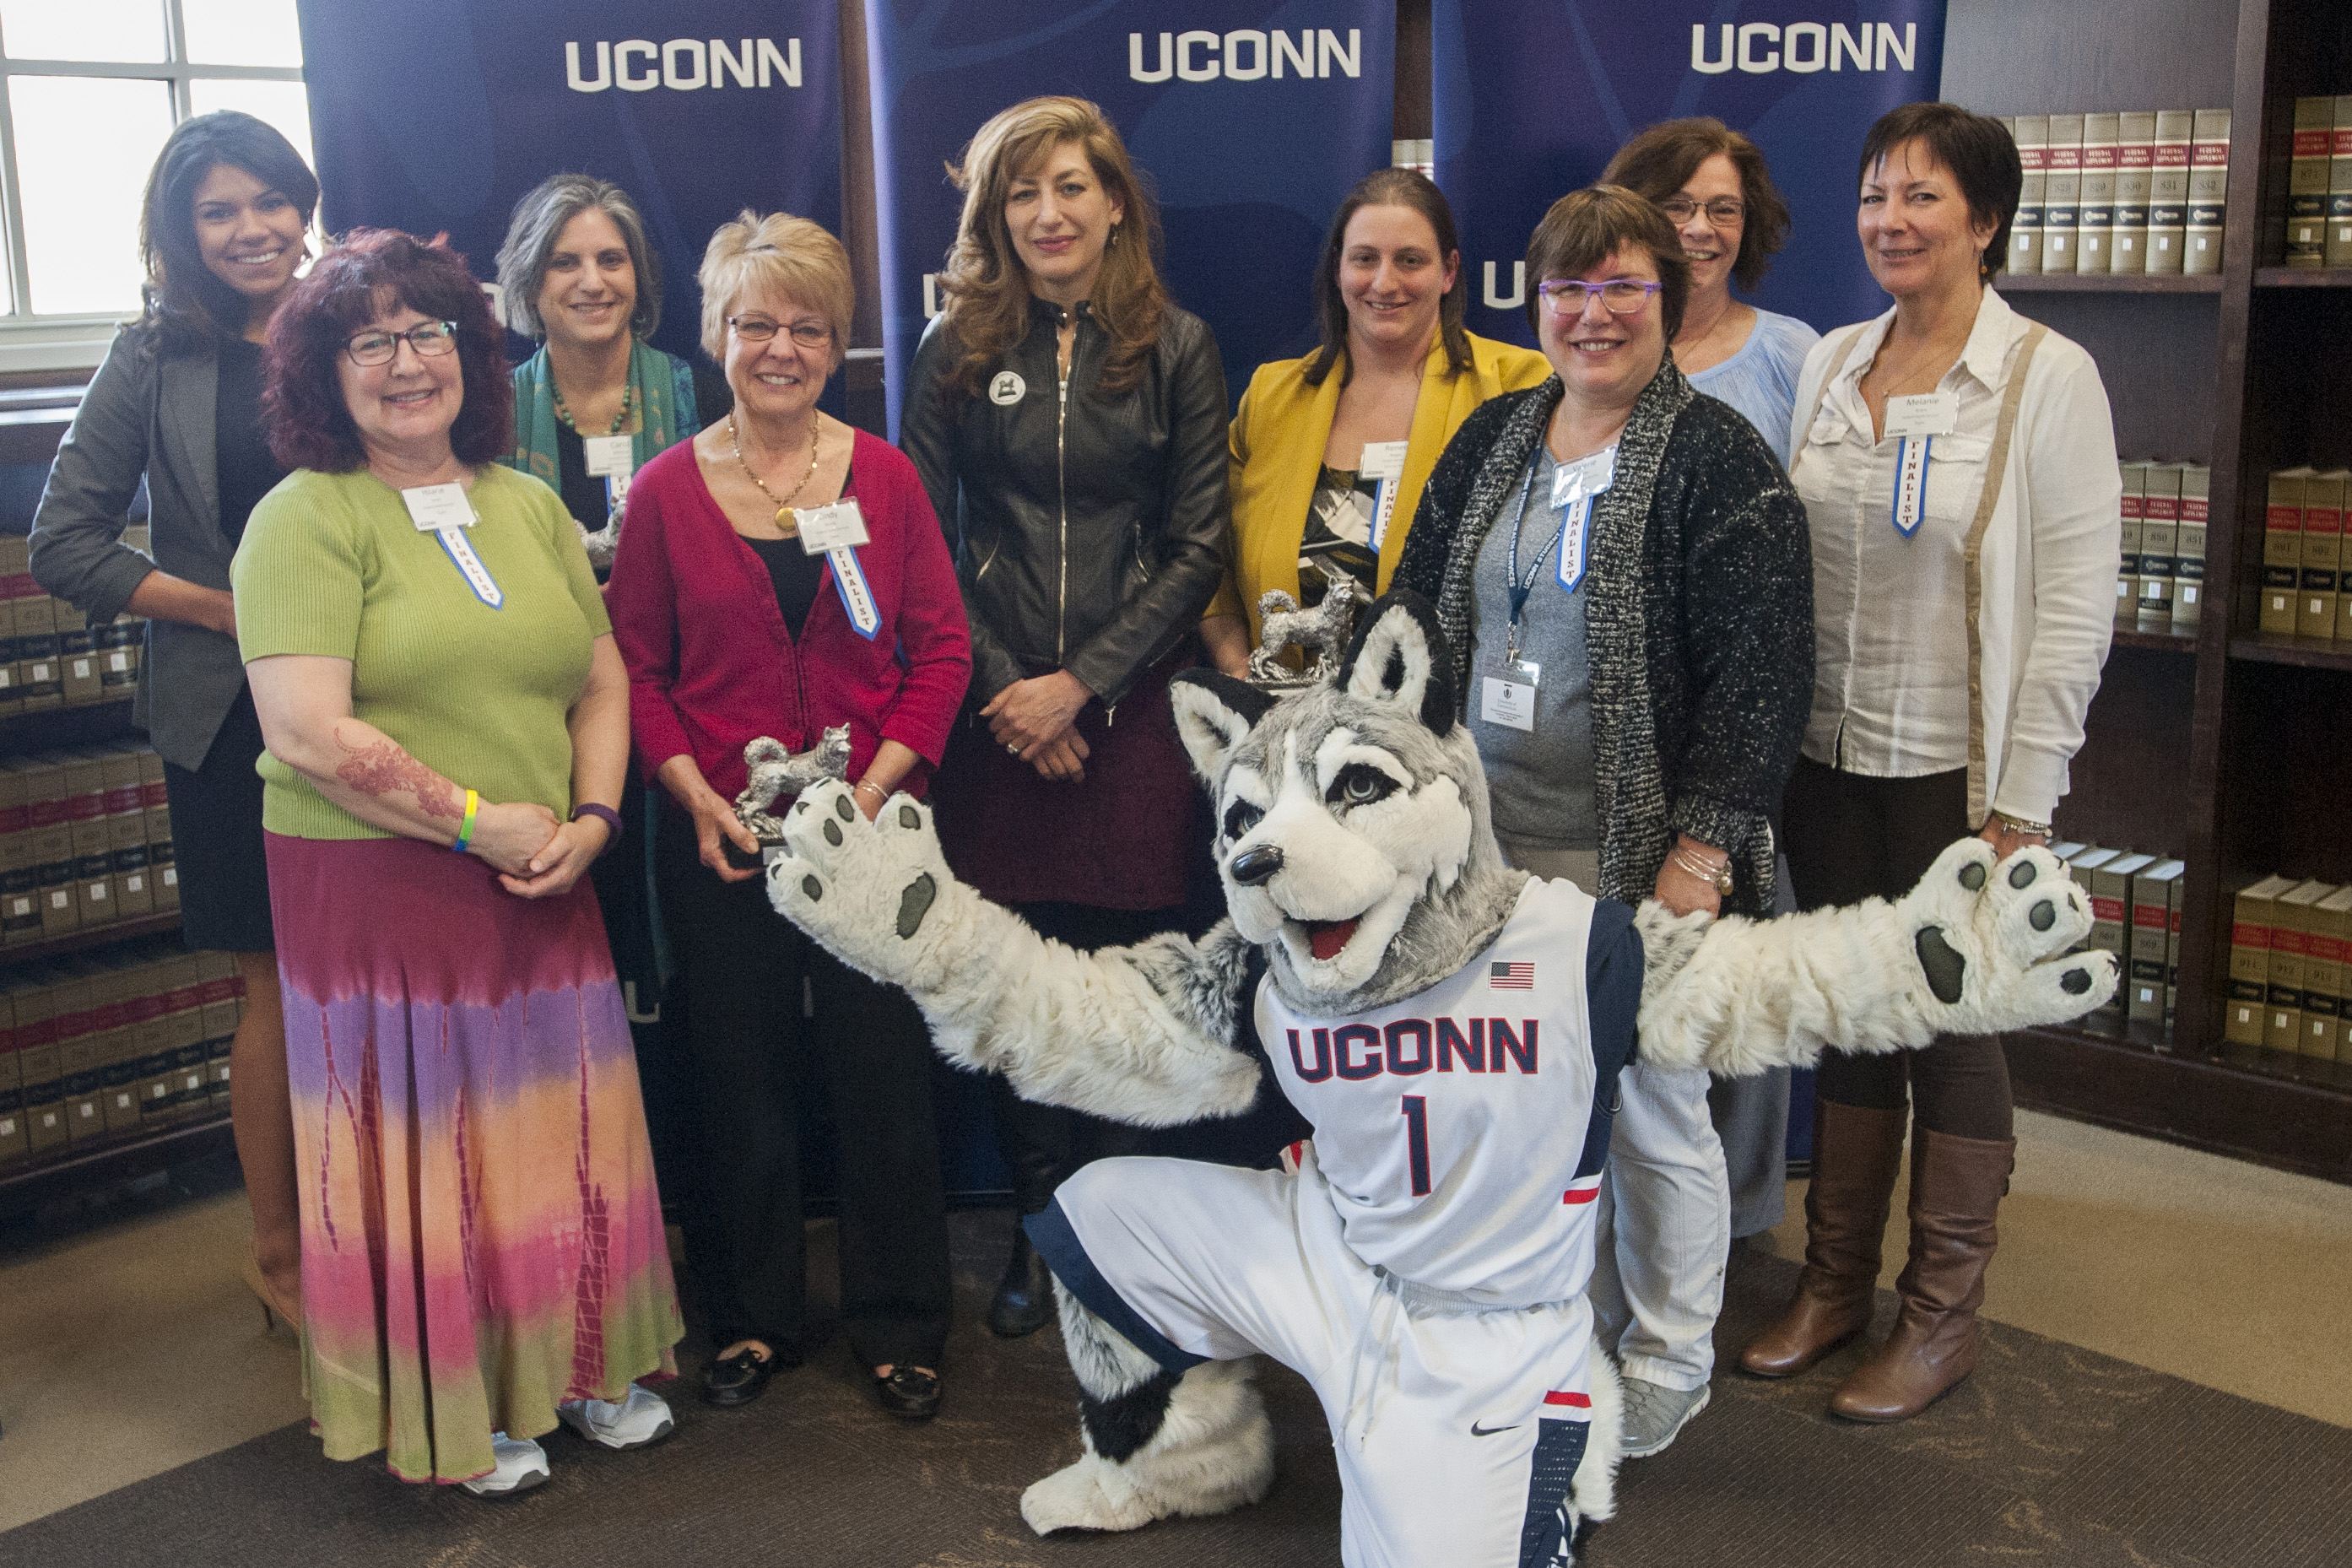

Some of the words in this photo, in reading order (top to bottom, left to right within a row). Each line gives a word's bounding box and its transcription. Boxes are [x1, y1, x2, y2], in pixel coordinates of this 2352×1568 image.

[565, 38, 803, 92] UCONN
[1129, 29, 1361, 83] UCONN
[1691, 22, 1917, 73] UCONN
[1902, 440, 1920, 524] FINALIST
[448, 532, 495, 600] FINALIST
[1508, 550, 1517, 587] SERVICES
[1523, 563, 1538, 590] UCONN
[1537, 533, 1560, 563] STUDENT
[1566, 500, 1584, 580] FINALIST
[836, 550, 871, 625] FINALIST
[1286, 1017, 1539, 1084] UCONN
[1402, 1095, 1432, 1198] 1
